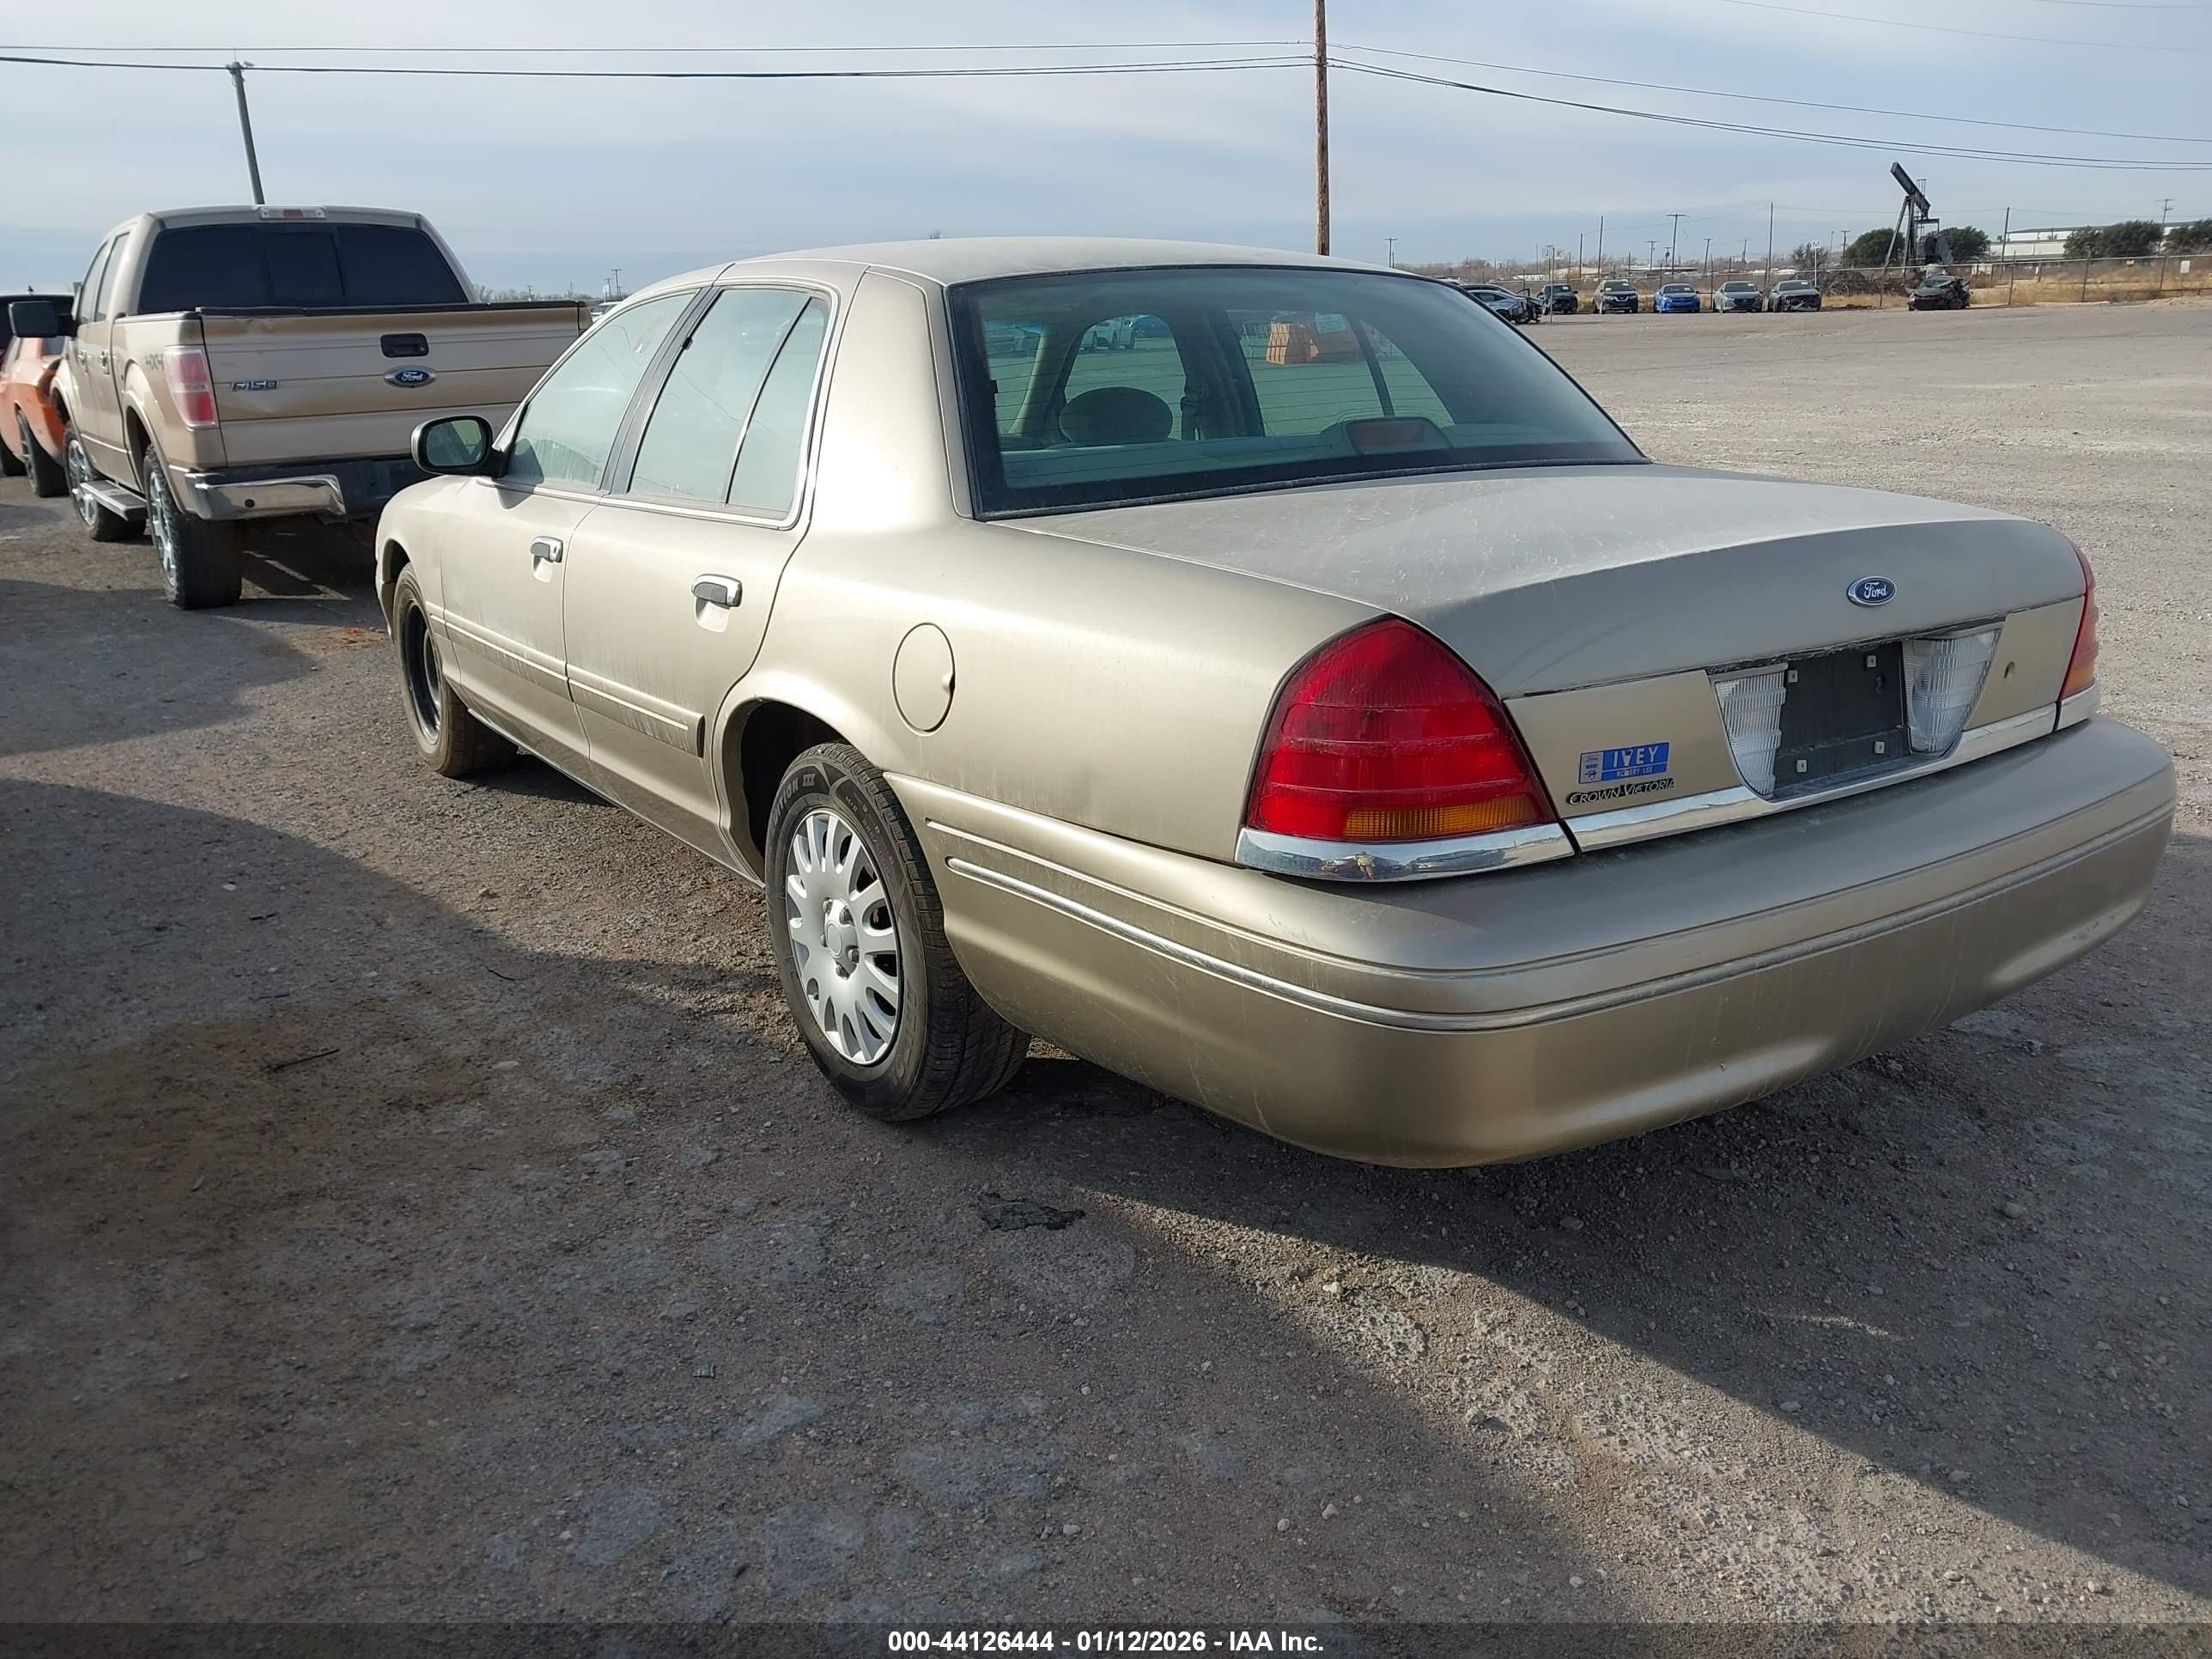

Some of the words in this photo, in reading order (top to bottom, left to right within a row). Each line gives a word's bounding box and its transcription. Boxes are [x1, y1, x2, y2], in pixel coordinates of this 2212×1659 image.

[400, 371, 423, 381] Ford
[1863, 581, 1888, 599] Ford
[1613, 746, 1658, 768] IVEY
[1570, 788, 1620, 805] CROWN
[1623, 778, 1675, 795] VICTORIA
